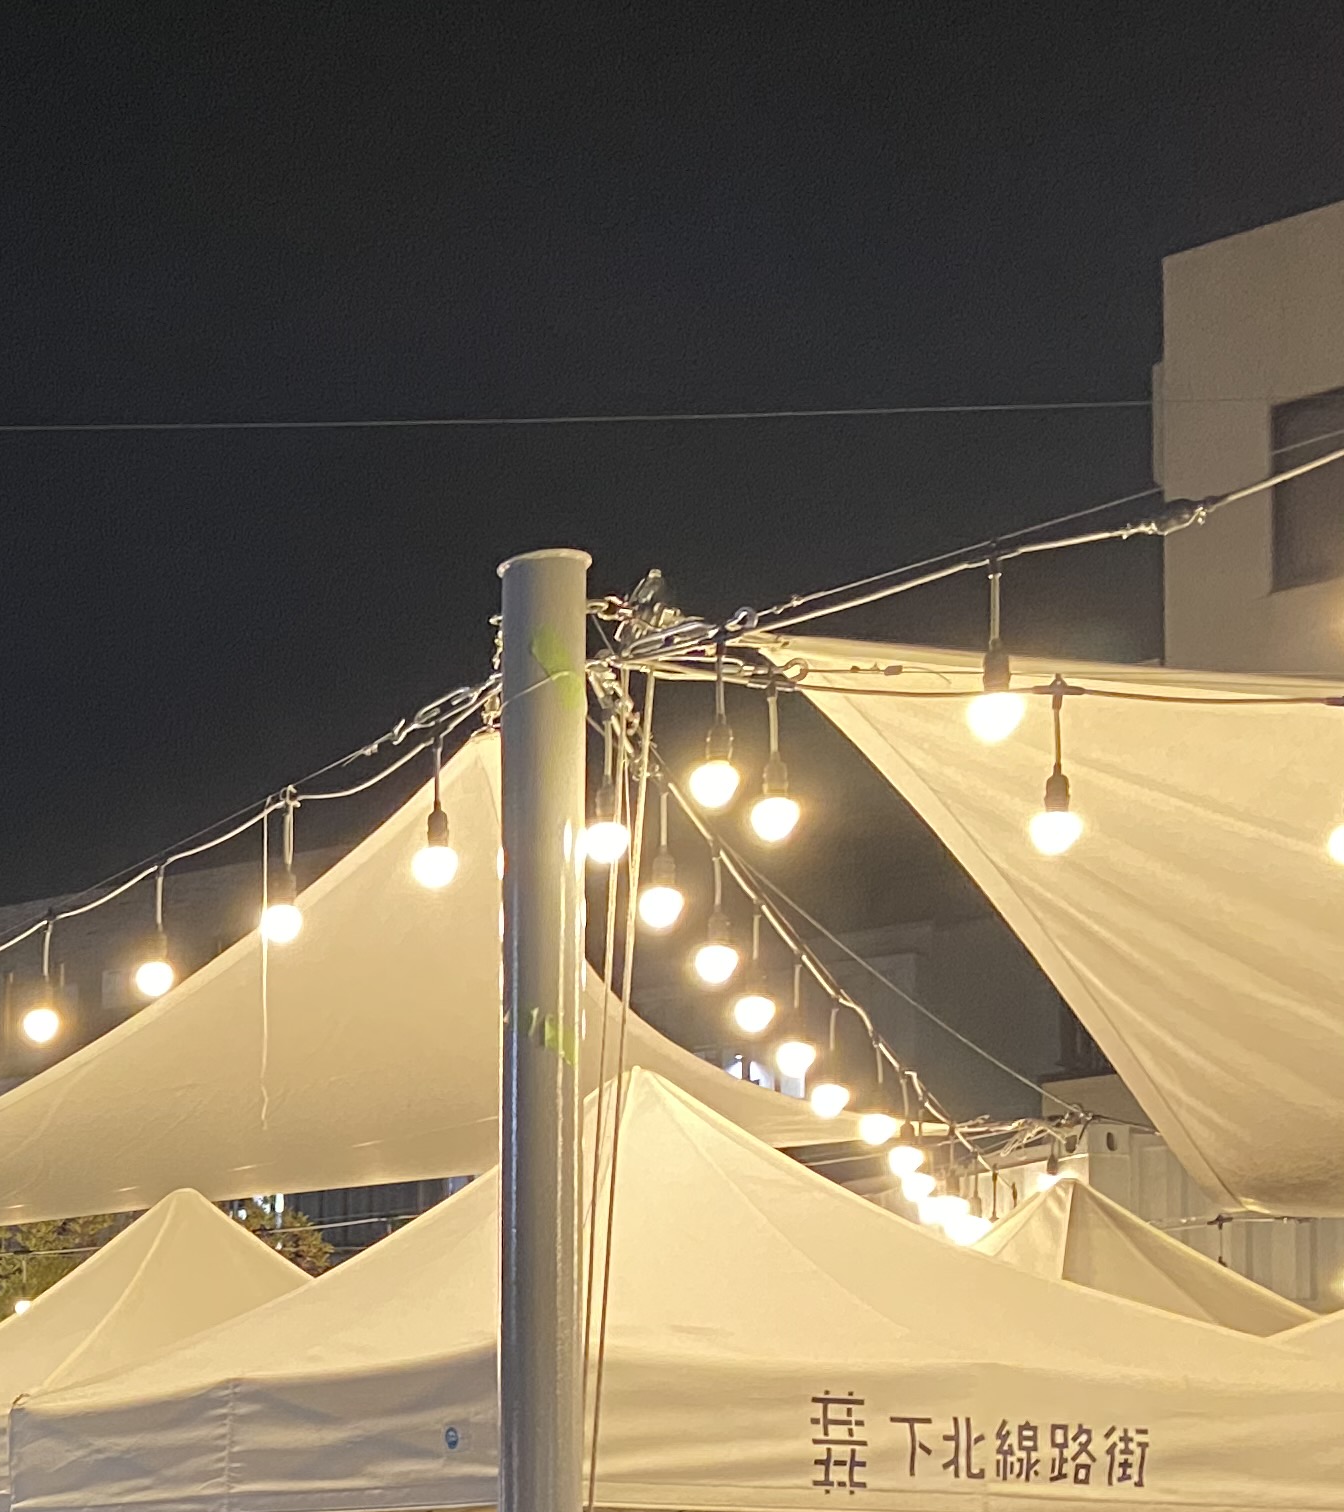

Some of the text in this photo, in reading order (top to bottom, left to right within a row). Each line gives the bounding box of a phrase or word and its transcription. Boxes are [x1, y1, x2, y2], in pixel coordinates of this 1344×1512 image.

[889, 1416, 1149, 1489] 下北線路街
